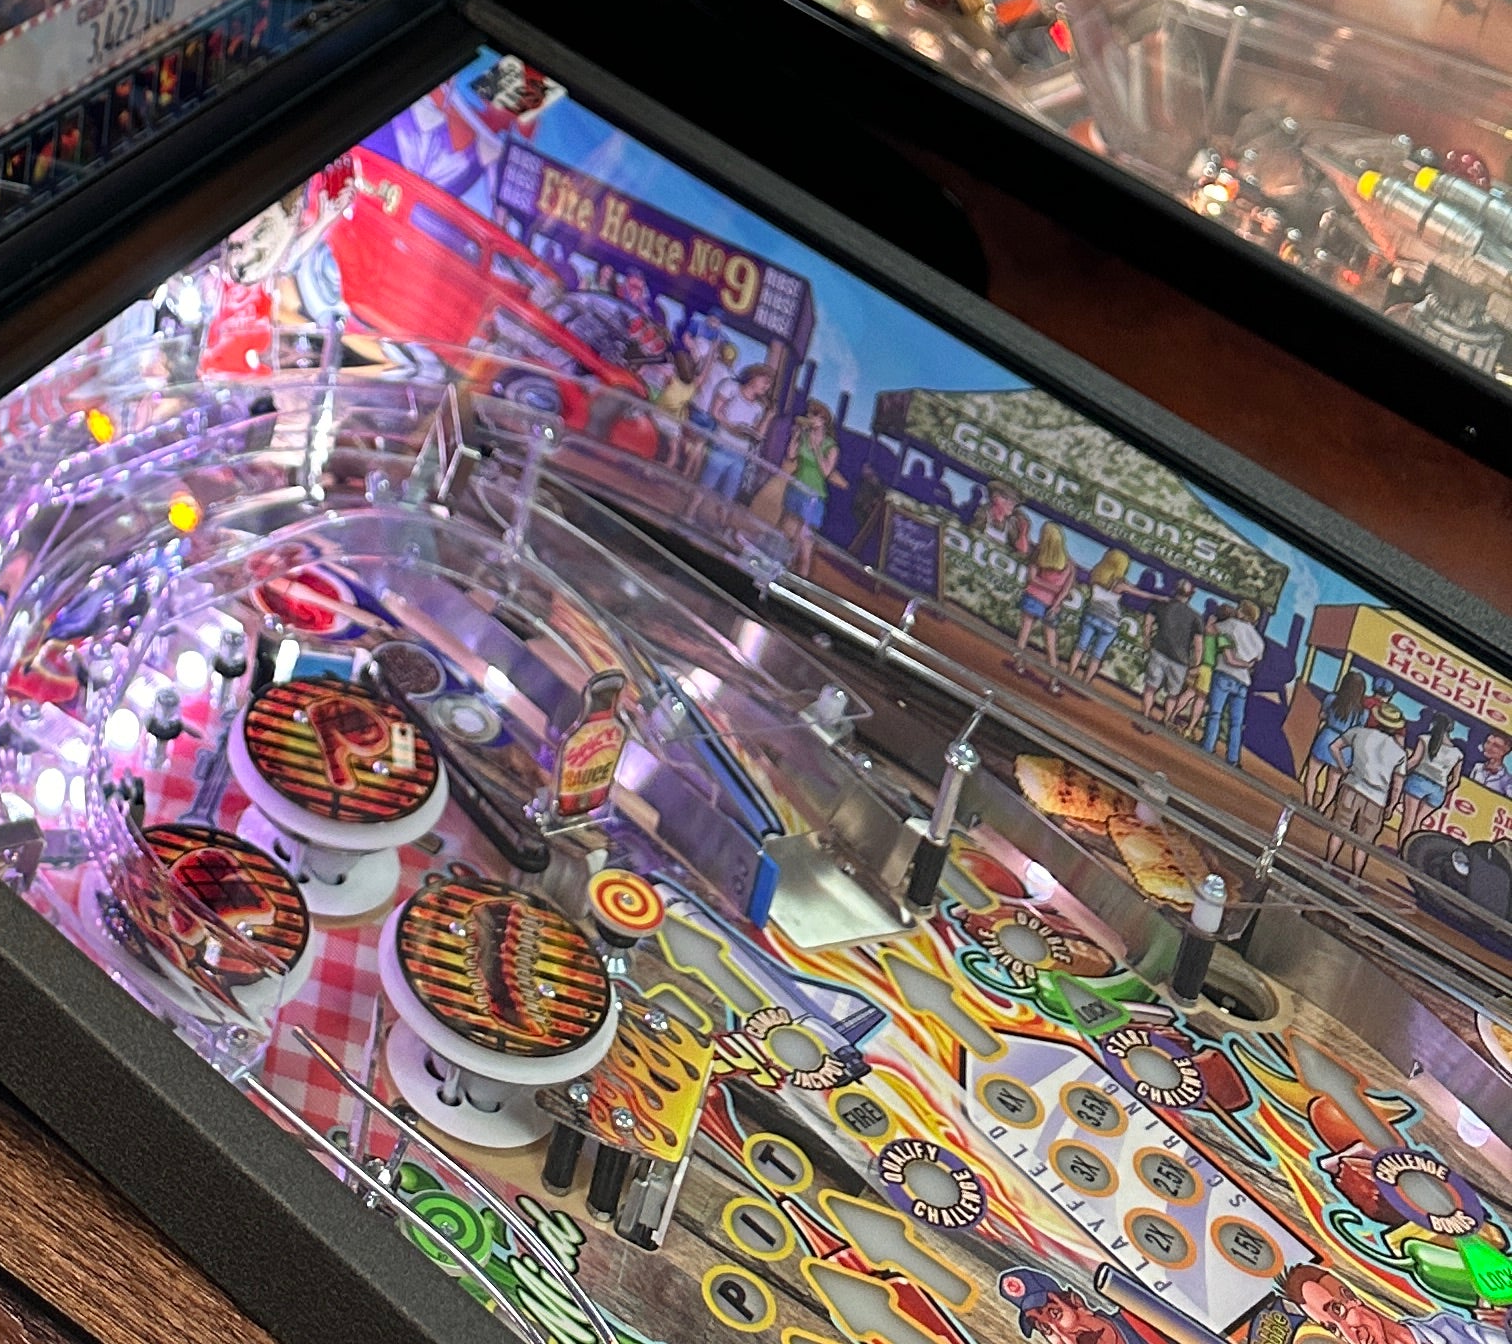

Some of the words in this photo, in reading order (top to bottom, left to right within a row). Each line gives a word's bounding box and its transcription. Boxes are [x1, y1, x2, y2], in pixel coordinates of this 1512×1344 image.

[600, 194, 686, 275] House
[719, 254, 761, 315] 9
[951, 421, 1082, 496] Gator
[1388, 652, 1509, 724] Hobble
[1390, 632, 1512, 705] Gobble
[1016, 911, 1071, 965] DOUBLE
[1106, 1029, 1150, 1058] START
[792, 1055, 845, 1090] JACKPOT
[1136, 1056, 1204, 1106] CHALLENGE
[996, 1087, 1027, 1114] 4X
[1076, 1091, 1111, 1128] 3.5X
[882, 1142, 938, 1183] QUALIFY
[1070, 1154, 1101, 1183] 3X
[1152, 1156, 1189, 1198] 2.5X
[1376, 1154, 1448, 1185] CHALLENGE
[912, 1169, 983, 1227] CHALLENGE
[1144, 1223, 1177, 1254] 2X
[1430, 1210, 1476, 1235] BONUS
[1231, 1227, 1266, 1266] 1.5X
